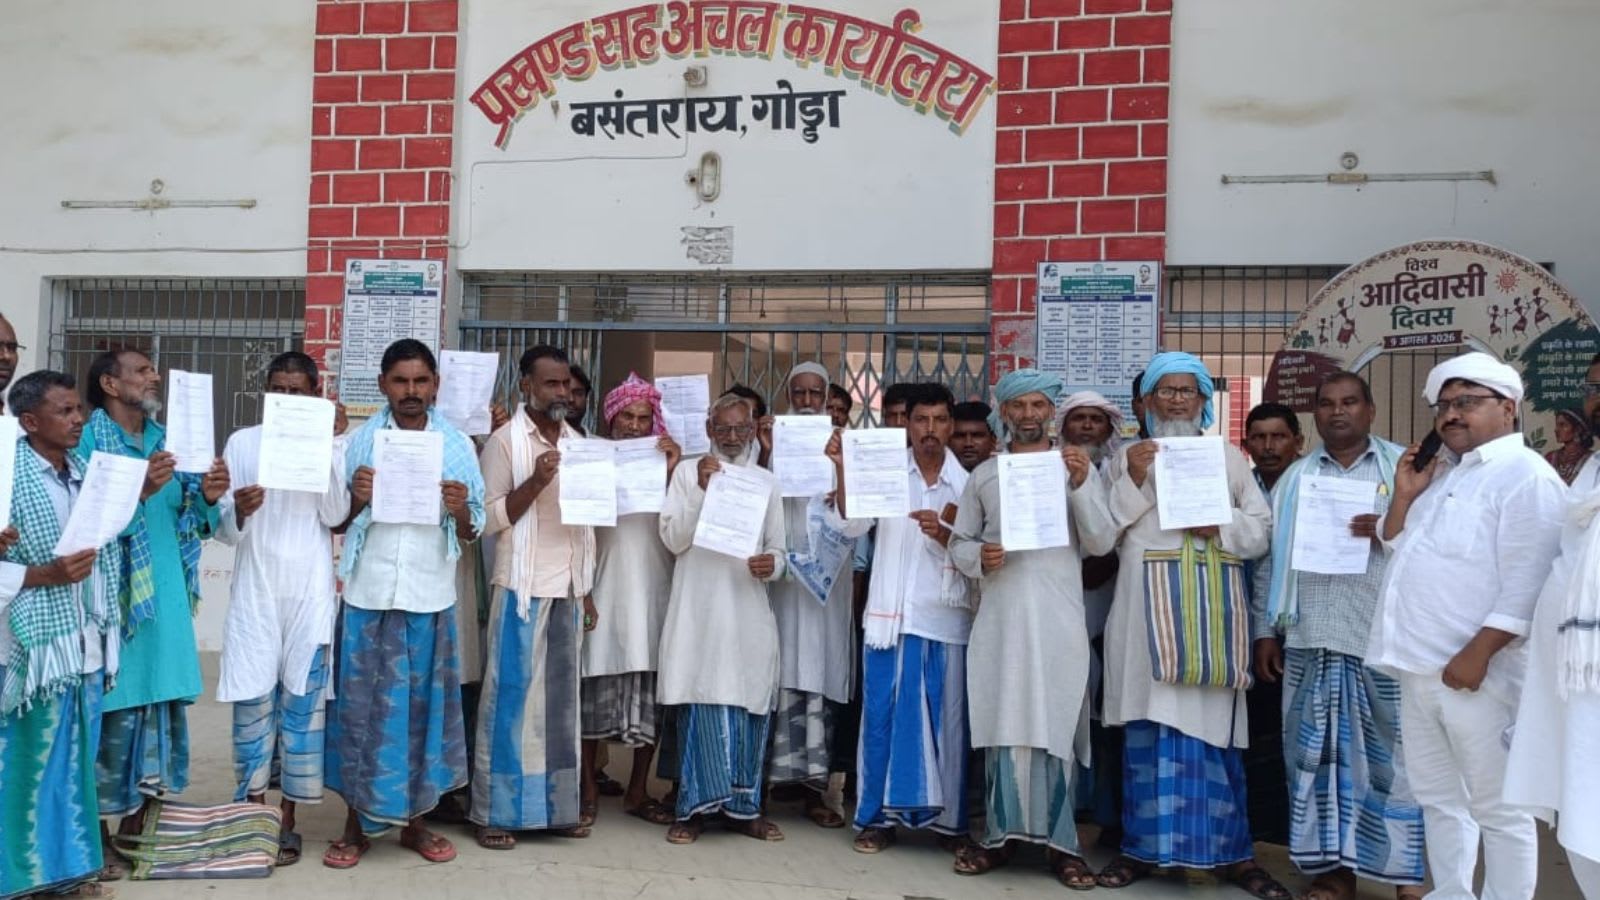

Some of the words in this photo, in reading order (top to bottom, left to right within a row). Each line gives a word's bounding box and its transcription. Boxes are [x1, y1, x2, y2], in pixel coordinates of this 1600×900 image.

[469, 21, 592, 148] प्रखण्ड
[592, 3, 660, 69] सह
[783, 4, 996, 134] कार्यालय
[751, 79, 846, 144] गोड्डा
[1405, 258, 1439, 271] विश्व
[1360, 263, 1487, 307] आदिवासी
[1390, 305, 1455, 330] दिवस
[1399, 335, 1428, 346] अगस्त
